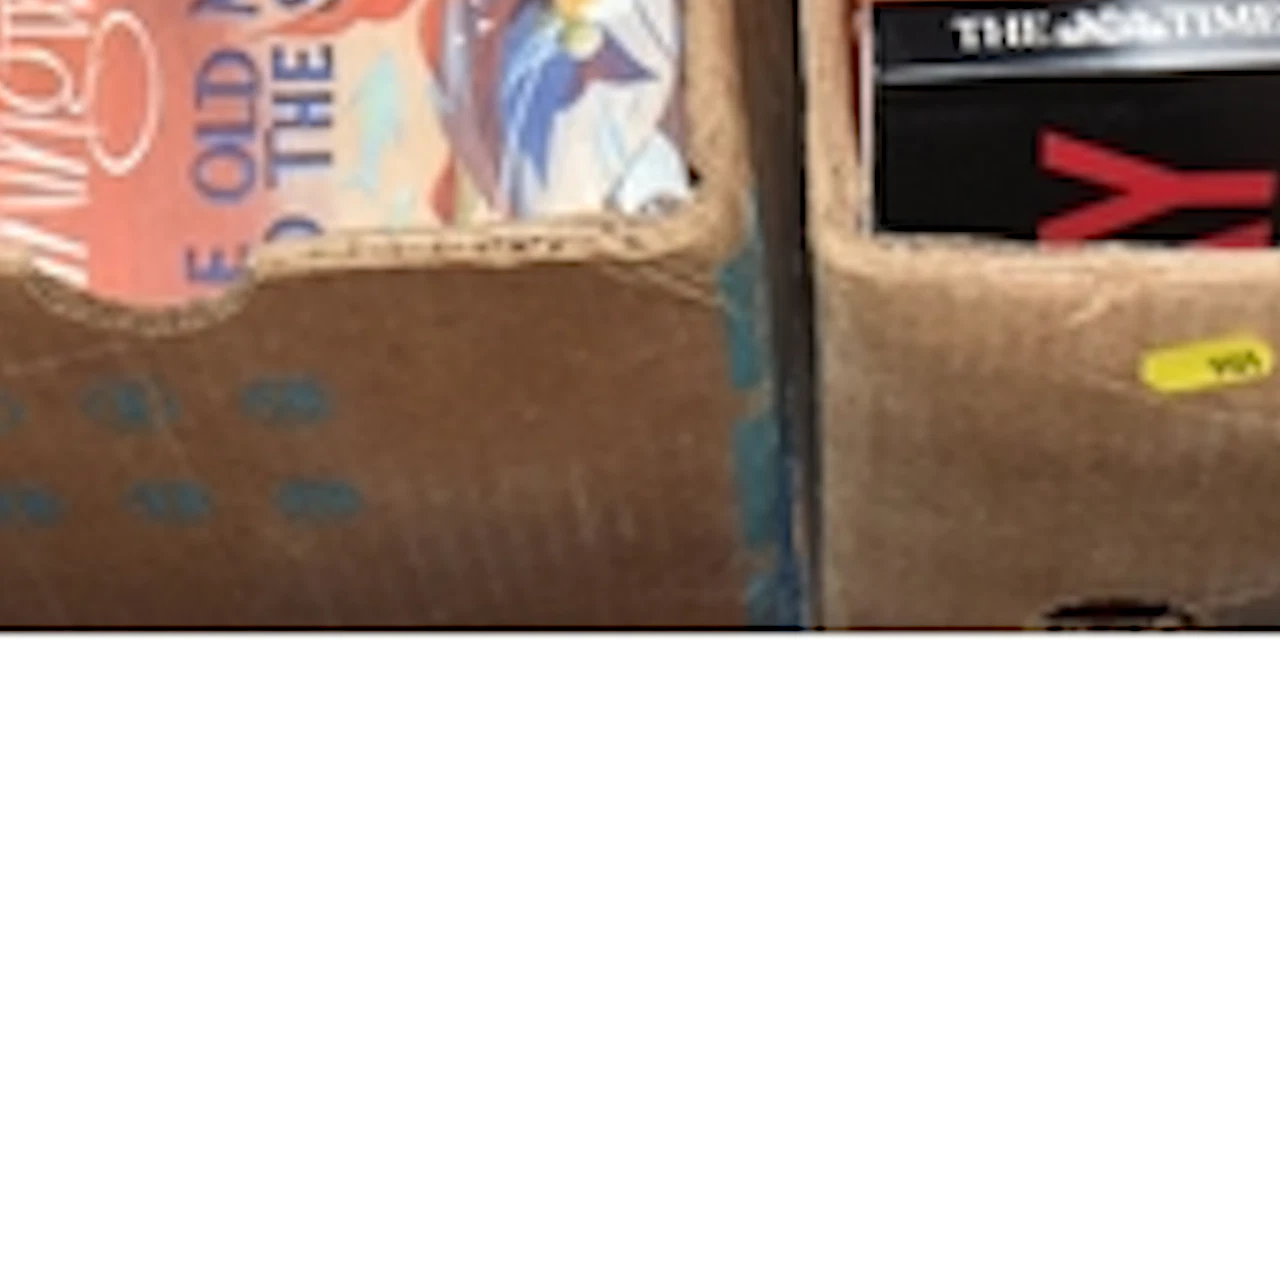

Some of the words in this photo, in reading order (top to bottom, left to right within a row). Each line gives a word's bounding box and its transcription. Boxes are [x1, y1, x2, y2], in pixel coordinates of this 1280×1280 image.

[950, 11, 1055, 55] THE
[194, 47, 262, 206] OLD
[264, 43, 336, 190] THE
